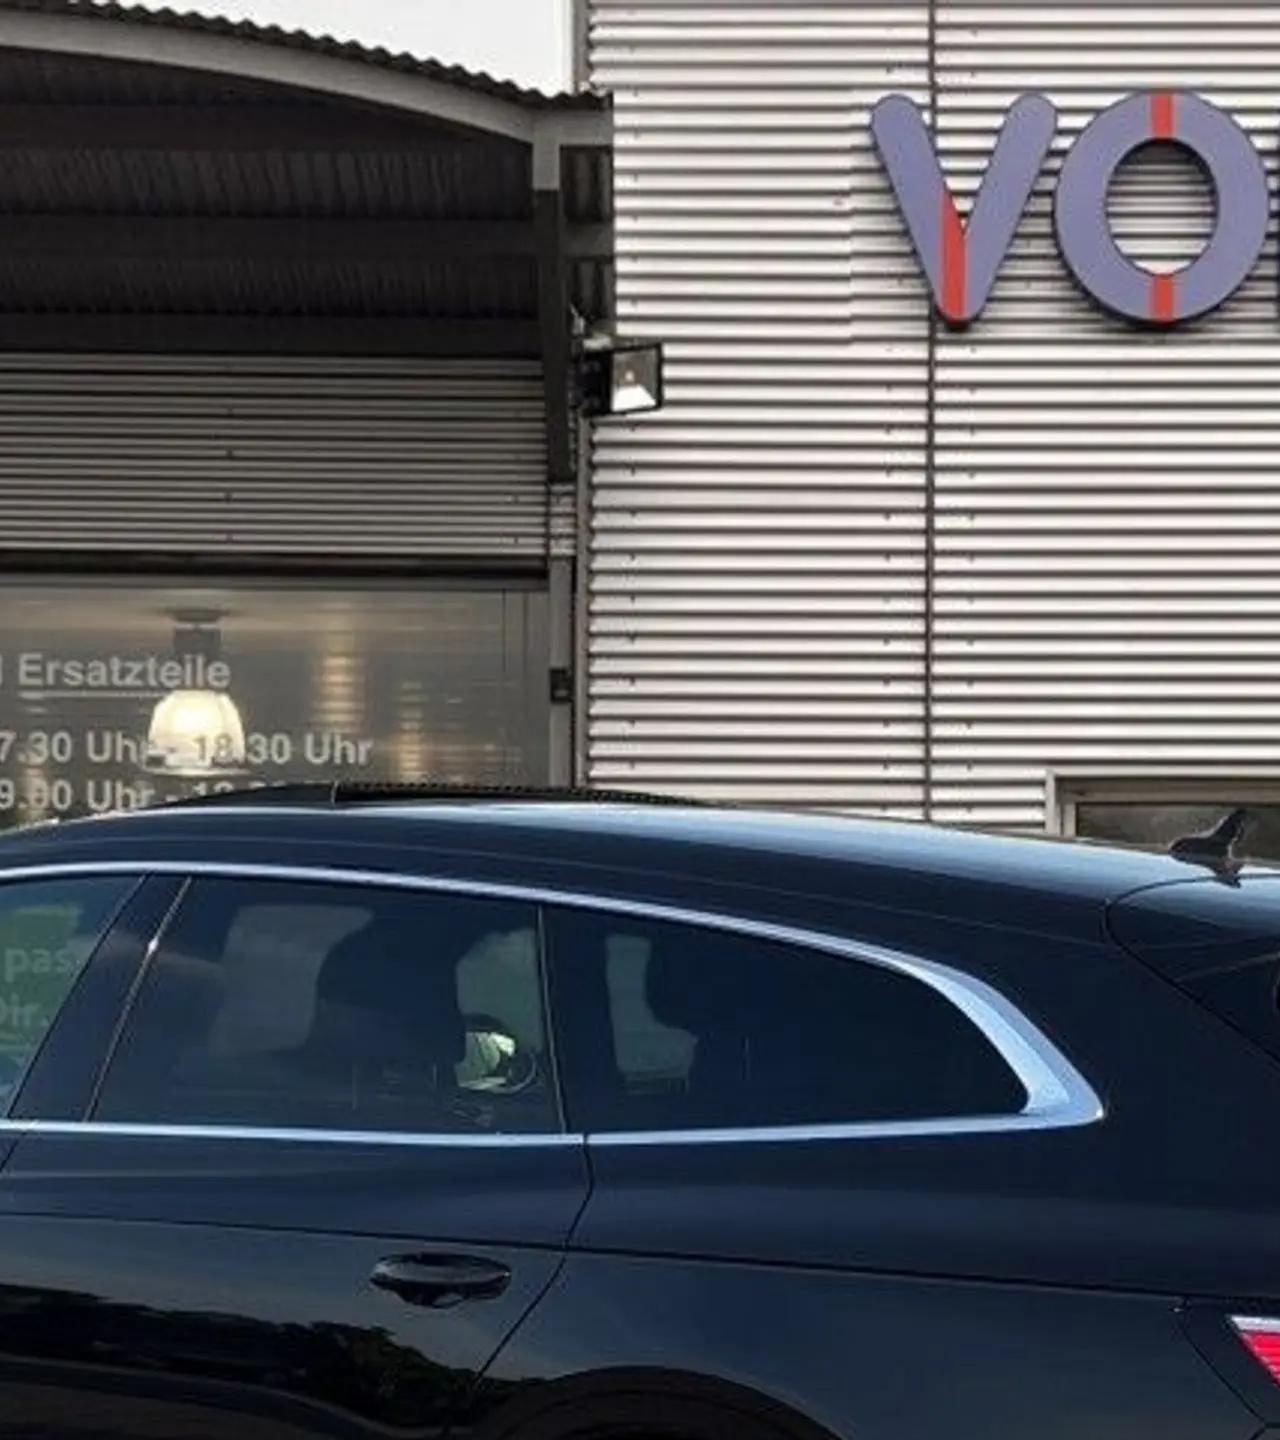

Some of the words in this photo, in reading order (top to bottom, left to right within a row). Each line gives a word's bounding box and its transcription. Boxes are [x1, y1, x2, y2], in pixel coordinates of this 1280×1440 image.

[19, 653, 231, 690] Ersatzteile
[304, 732, 373, 765] Uhr
[87, 780, 155, 811] Uhr
